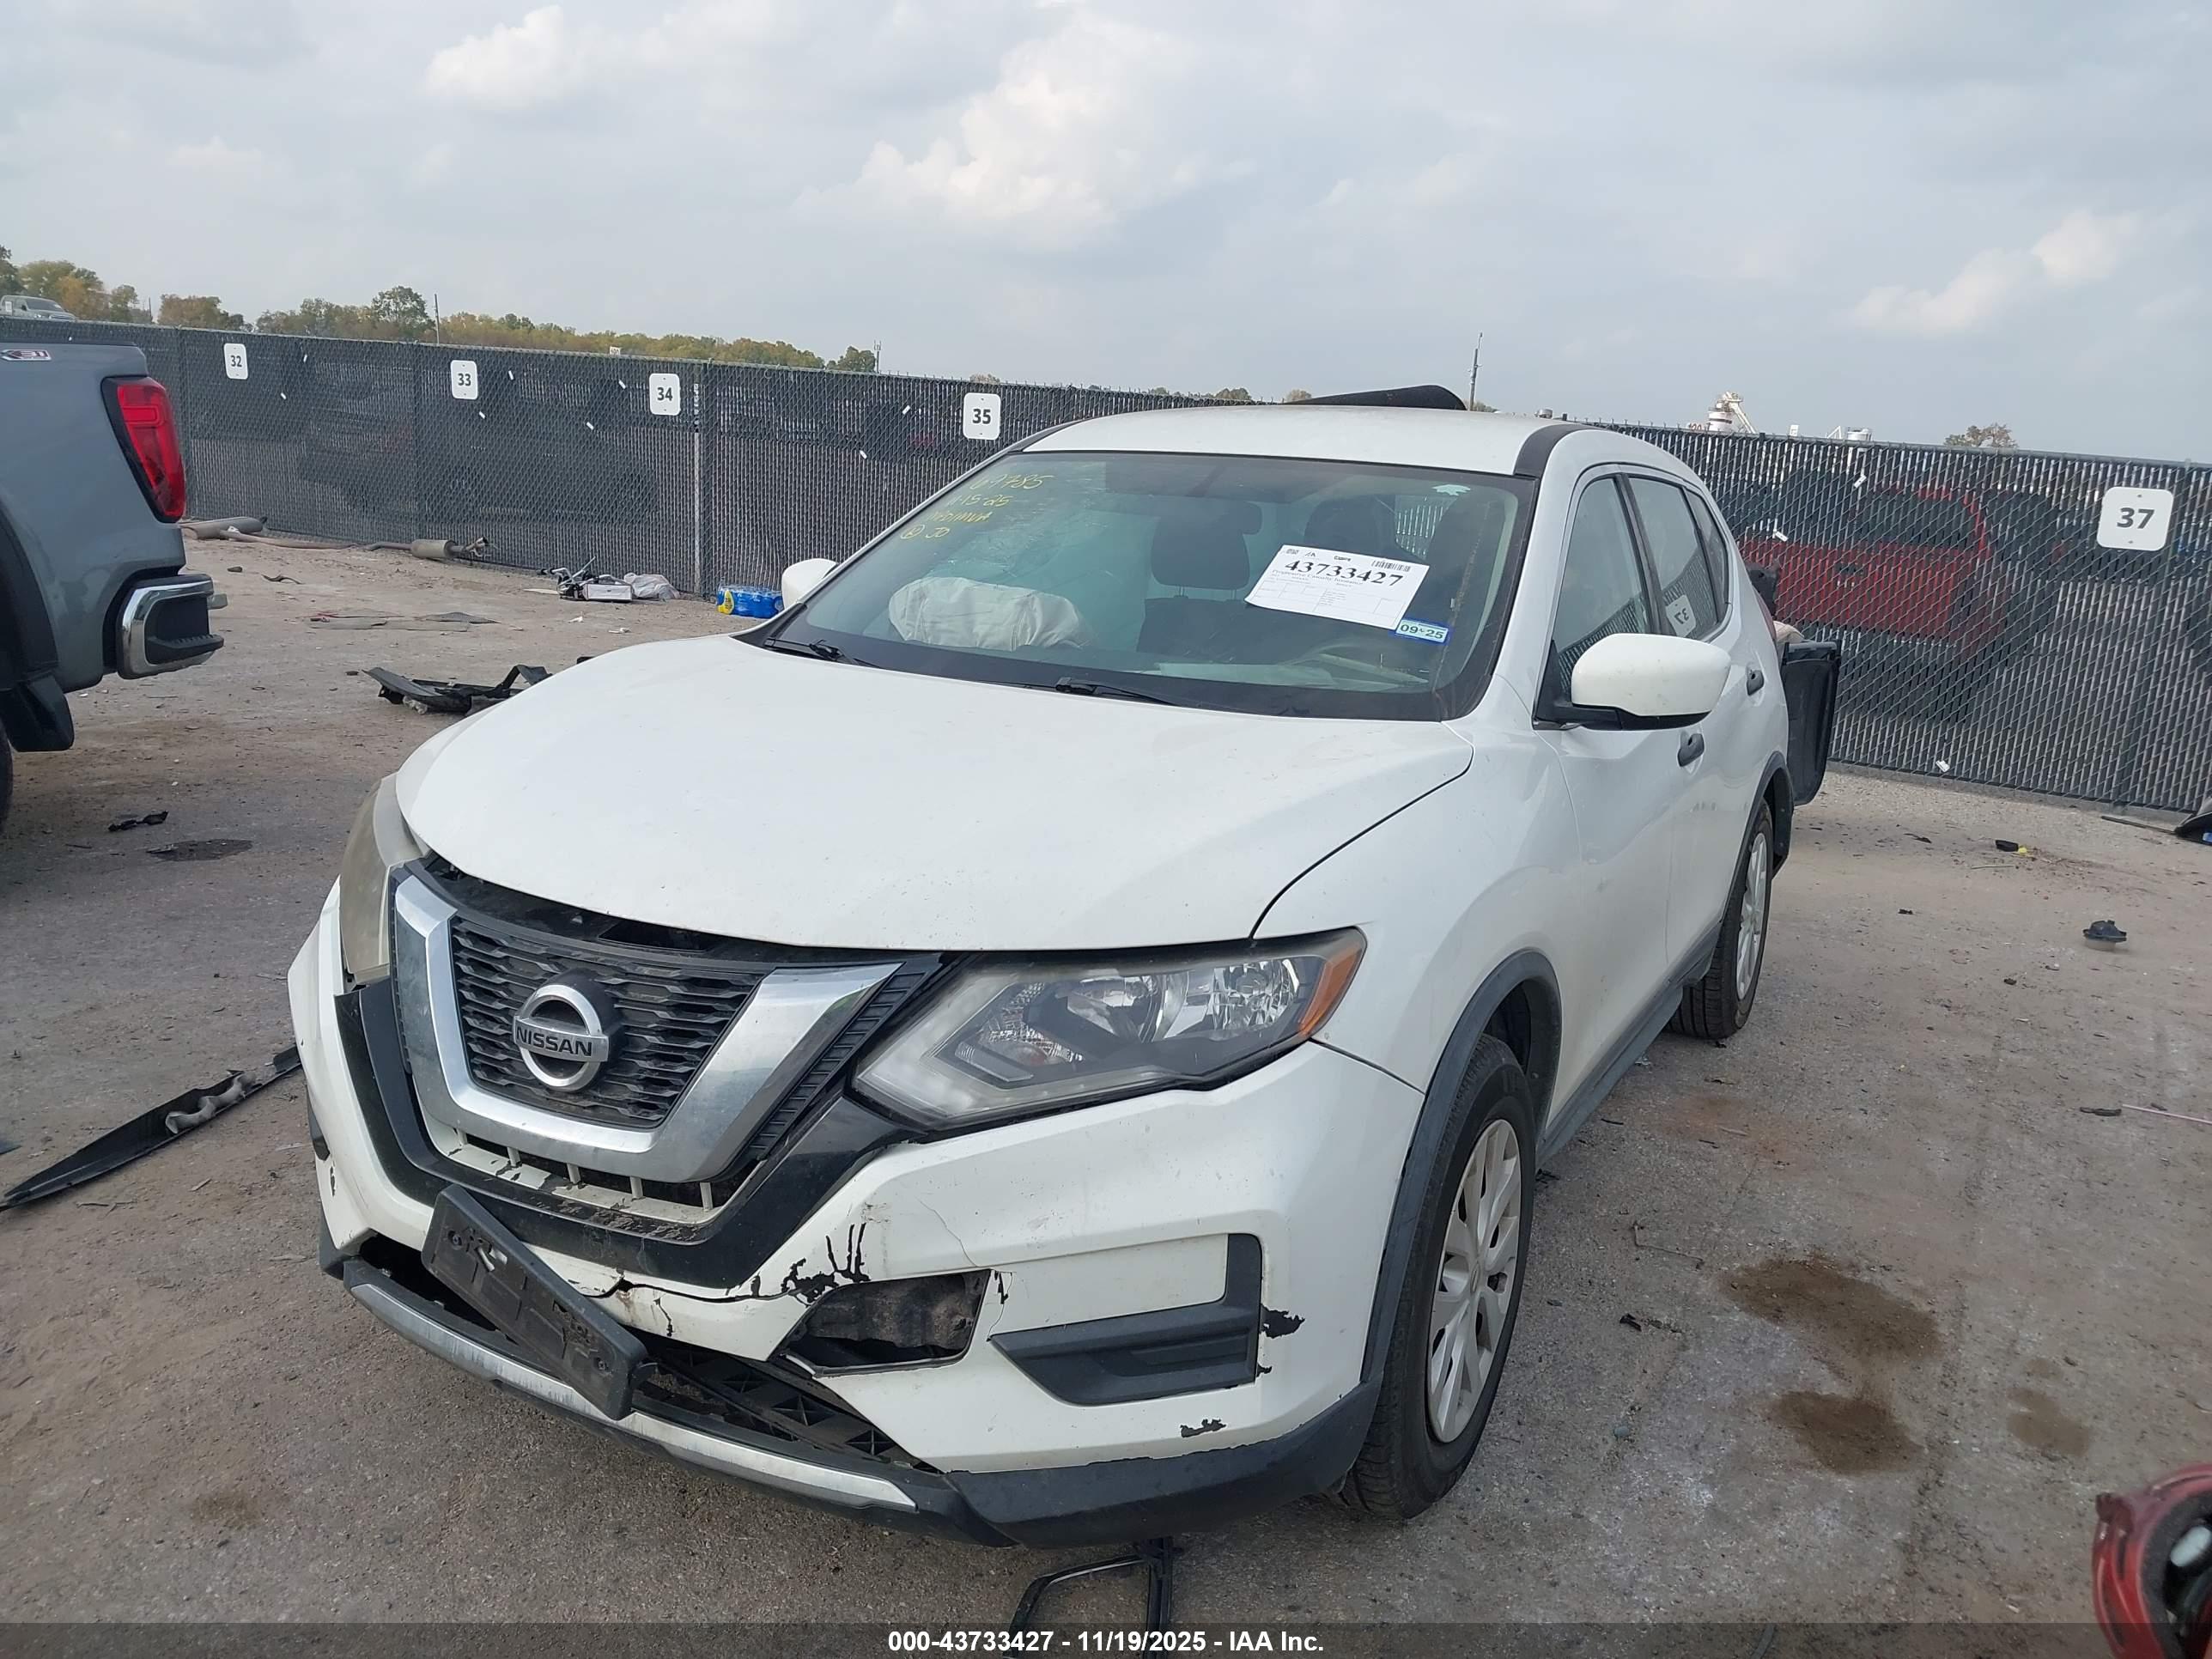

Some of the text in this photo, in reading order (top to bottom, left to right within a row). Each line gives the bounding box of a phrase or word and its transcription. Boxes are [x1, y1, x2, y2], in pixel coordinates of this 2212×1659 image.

[230, 355, 242, 368] 32
[458, 373, 471, 386] 33
[657, 386, 673, 401] 34
[972, 408, 991, 424] 35
[2117, 507, 2155, 529] 37
[1285, 560, 1403, 586] 43733427
[1401, 624, 1443, 639] 09 25
[517, 1026, 592, 1057] NISSAN
